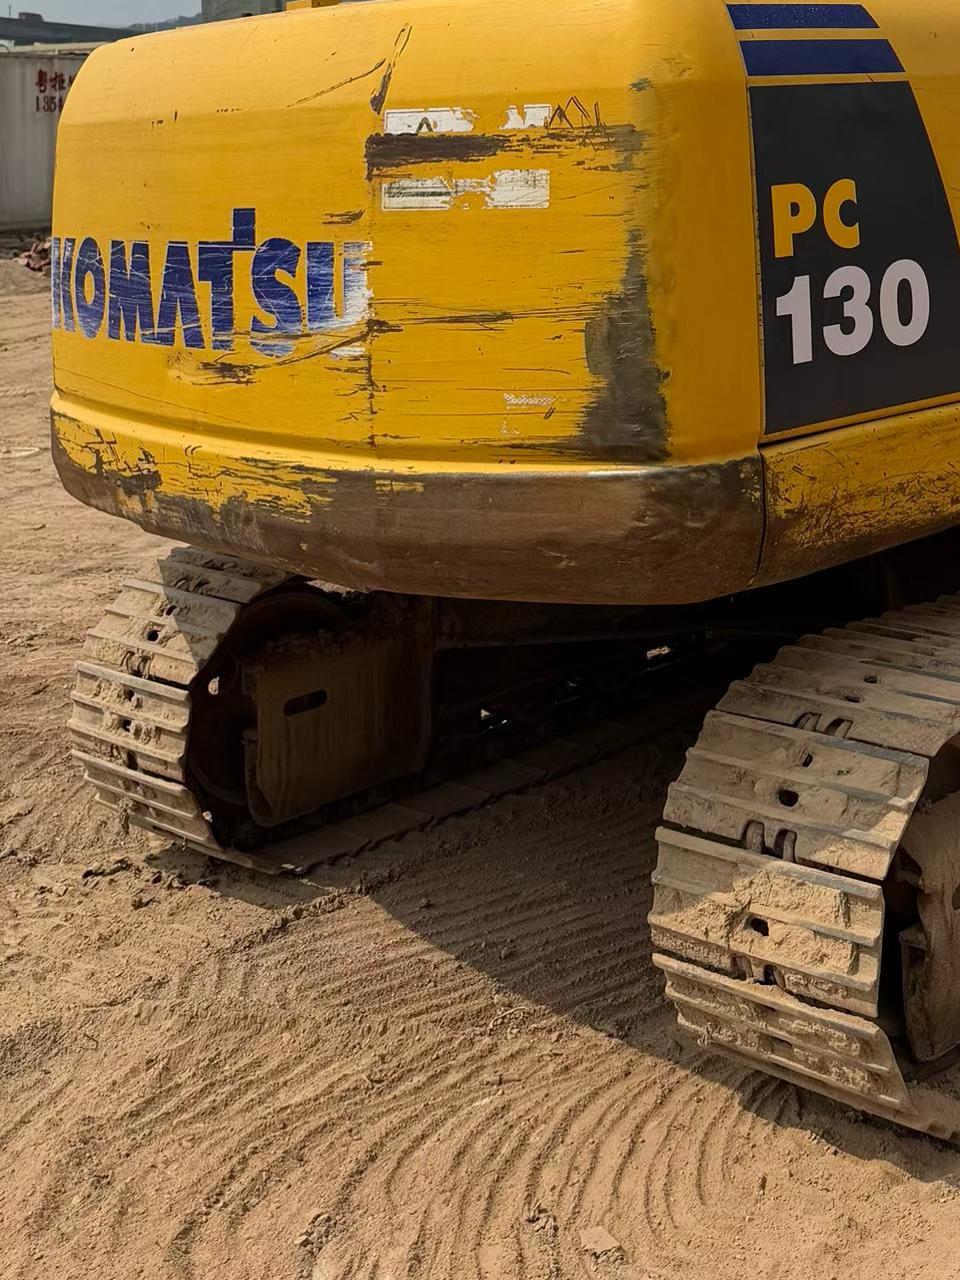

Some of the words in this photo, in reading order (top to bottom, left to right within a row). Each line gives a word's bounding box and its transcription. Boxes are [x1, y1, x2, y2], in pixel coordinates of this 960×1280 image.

[35, 69, 74, 93] 粤柜
[771, 178, 861, 259] PC
[52, 208, 371, 358] KOMATSU
[775, 258, 931, 365] 130
